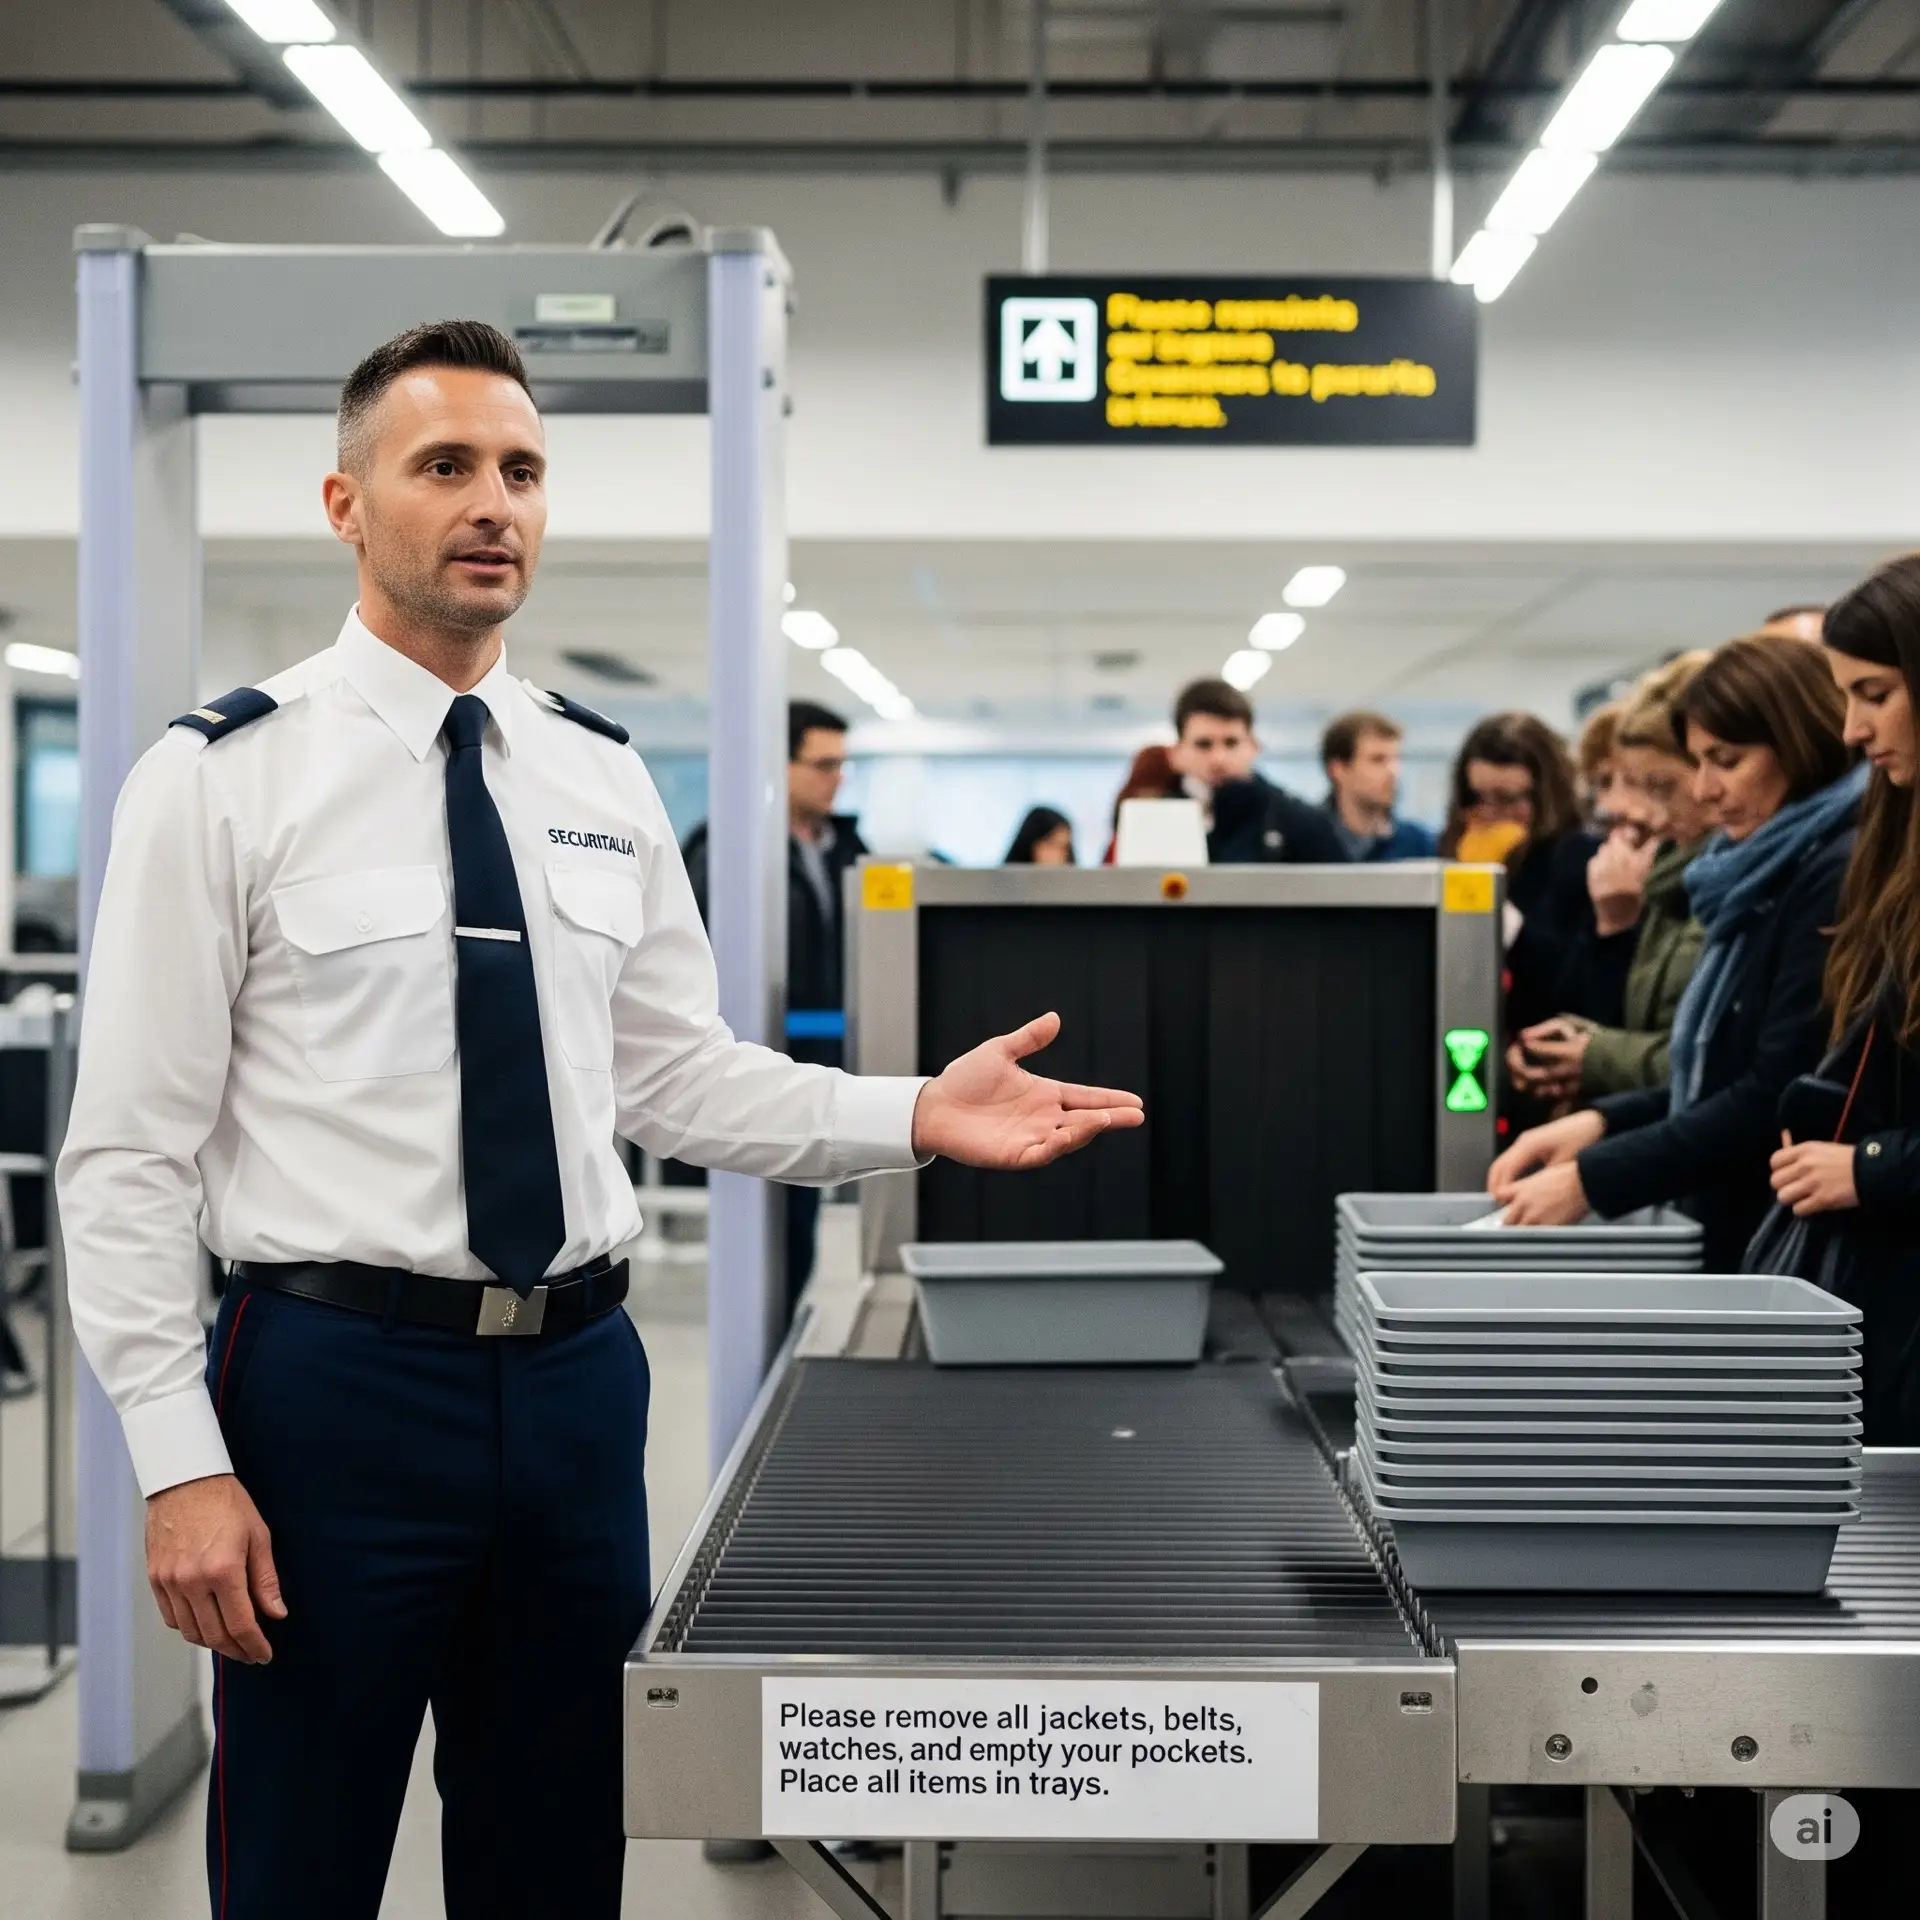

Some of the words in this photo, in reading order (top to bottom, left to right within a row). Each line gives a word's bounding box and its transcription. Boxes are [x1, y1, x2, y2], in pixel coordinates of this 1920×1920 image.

[547, 828, 636, 858] SECURITALIA
[780, 1702, 876, 1728] Please
[885, 1709, 988, 1729] remove
[997, 1703, 1028, 1730] all
[1037, 1704, 1154, 1737] jackets,
[1164, 1704, 1242, 1736] belts,
[779, 1736, 903, 1764] watches,
[910, 1735, 962, 1761] and
[969, 1737, 1053, 1769] empty
[1060, 1743, 1123, 1769] your
[1131, 1738, 1253, 1769] pockets.
[780, 1767, 858, 1793] Place
[867, 1768, 899, 1794] all
[909, 1769, 987, 1794] items
[996, 1769, 1020, 1795] in
[1029, 1772, 1109, 1802] trays.
